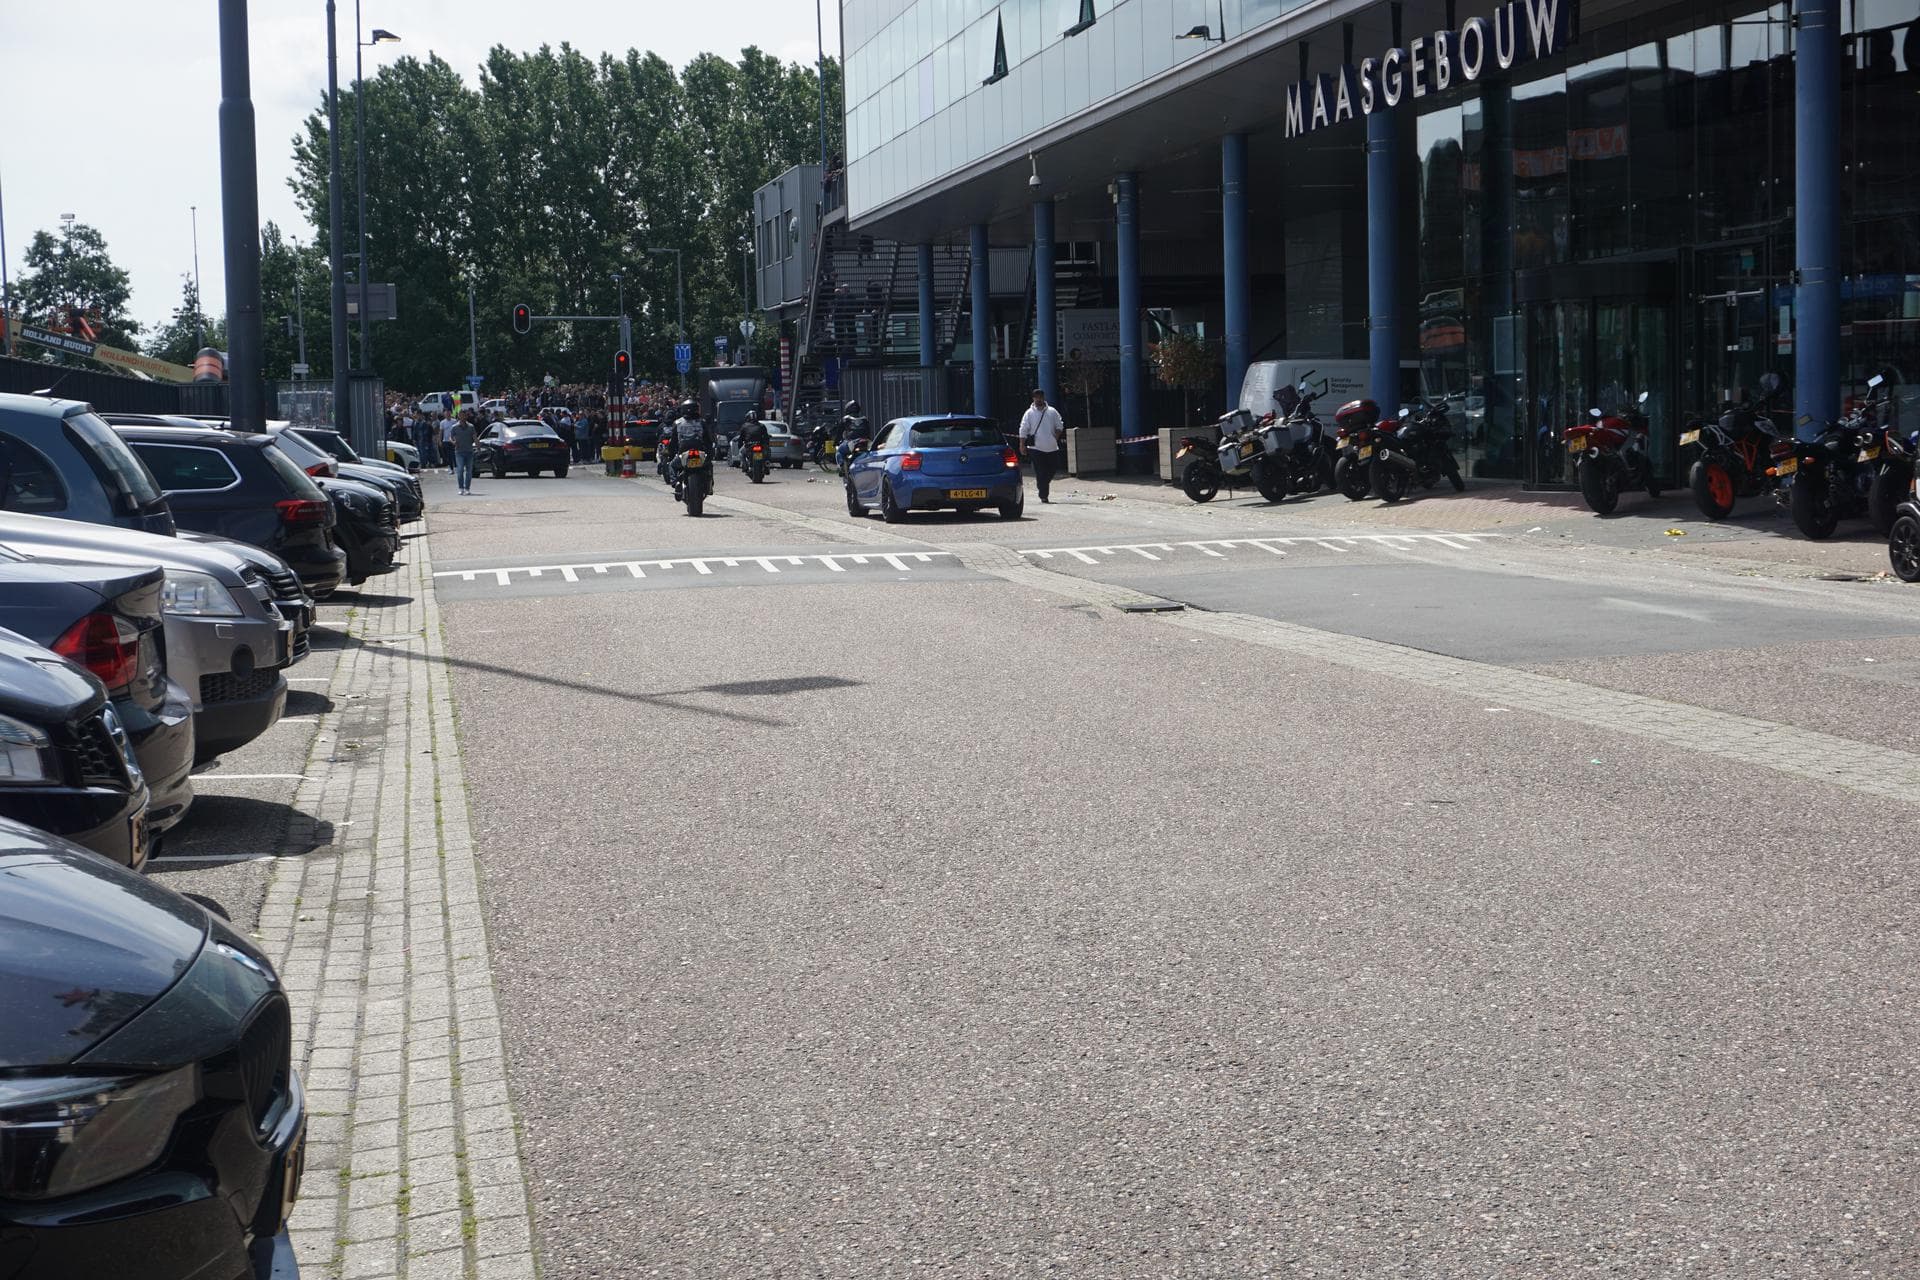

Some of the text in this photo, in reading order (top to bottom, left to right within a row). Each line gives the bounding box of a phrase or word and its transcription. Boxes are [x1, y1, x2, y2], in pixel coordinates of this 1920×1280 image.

[1285, 0, 1560, 138] MAASGEBOUW
[22, 328, 93, 353] HOLLAND HUURT
